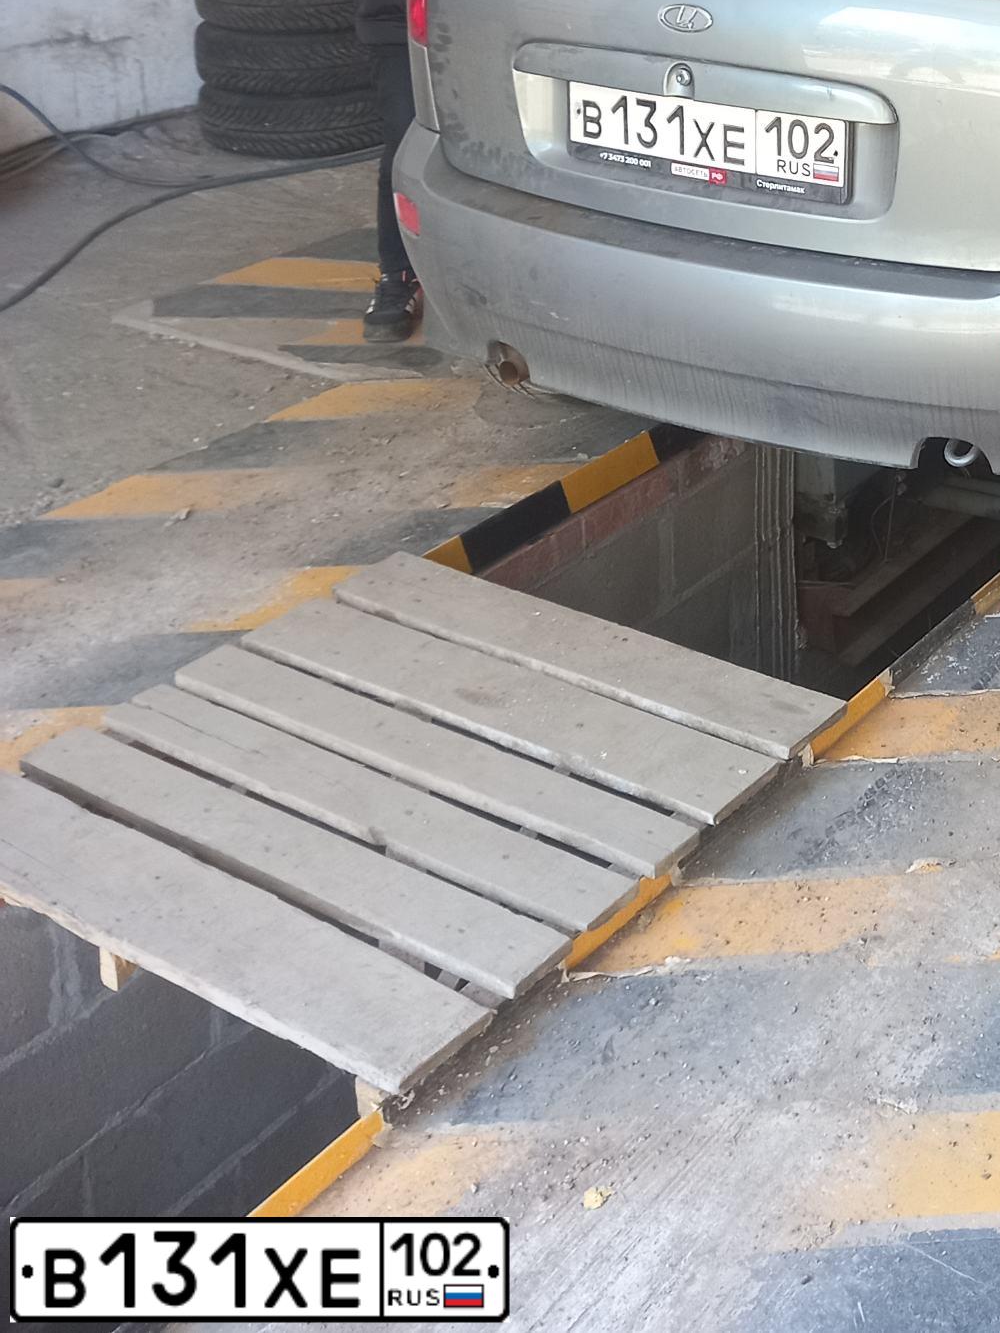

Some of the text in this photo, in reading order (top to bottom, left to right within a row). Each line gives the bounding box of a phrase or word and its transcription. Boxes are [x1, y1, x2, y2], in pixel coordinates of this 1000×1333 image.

[582, 95, 745, 166] В131ХЕ
[765, 116, 835, 164] 102
[624, 156, 639, 166] 200
[638, 158, 652, 168] 001
[777, 159, 811, 177] RUS
[756, 178, 806, 194] Стерлитамак
